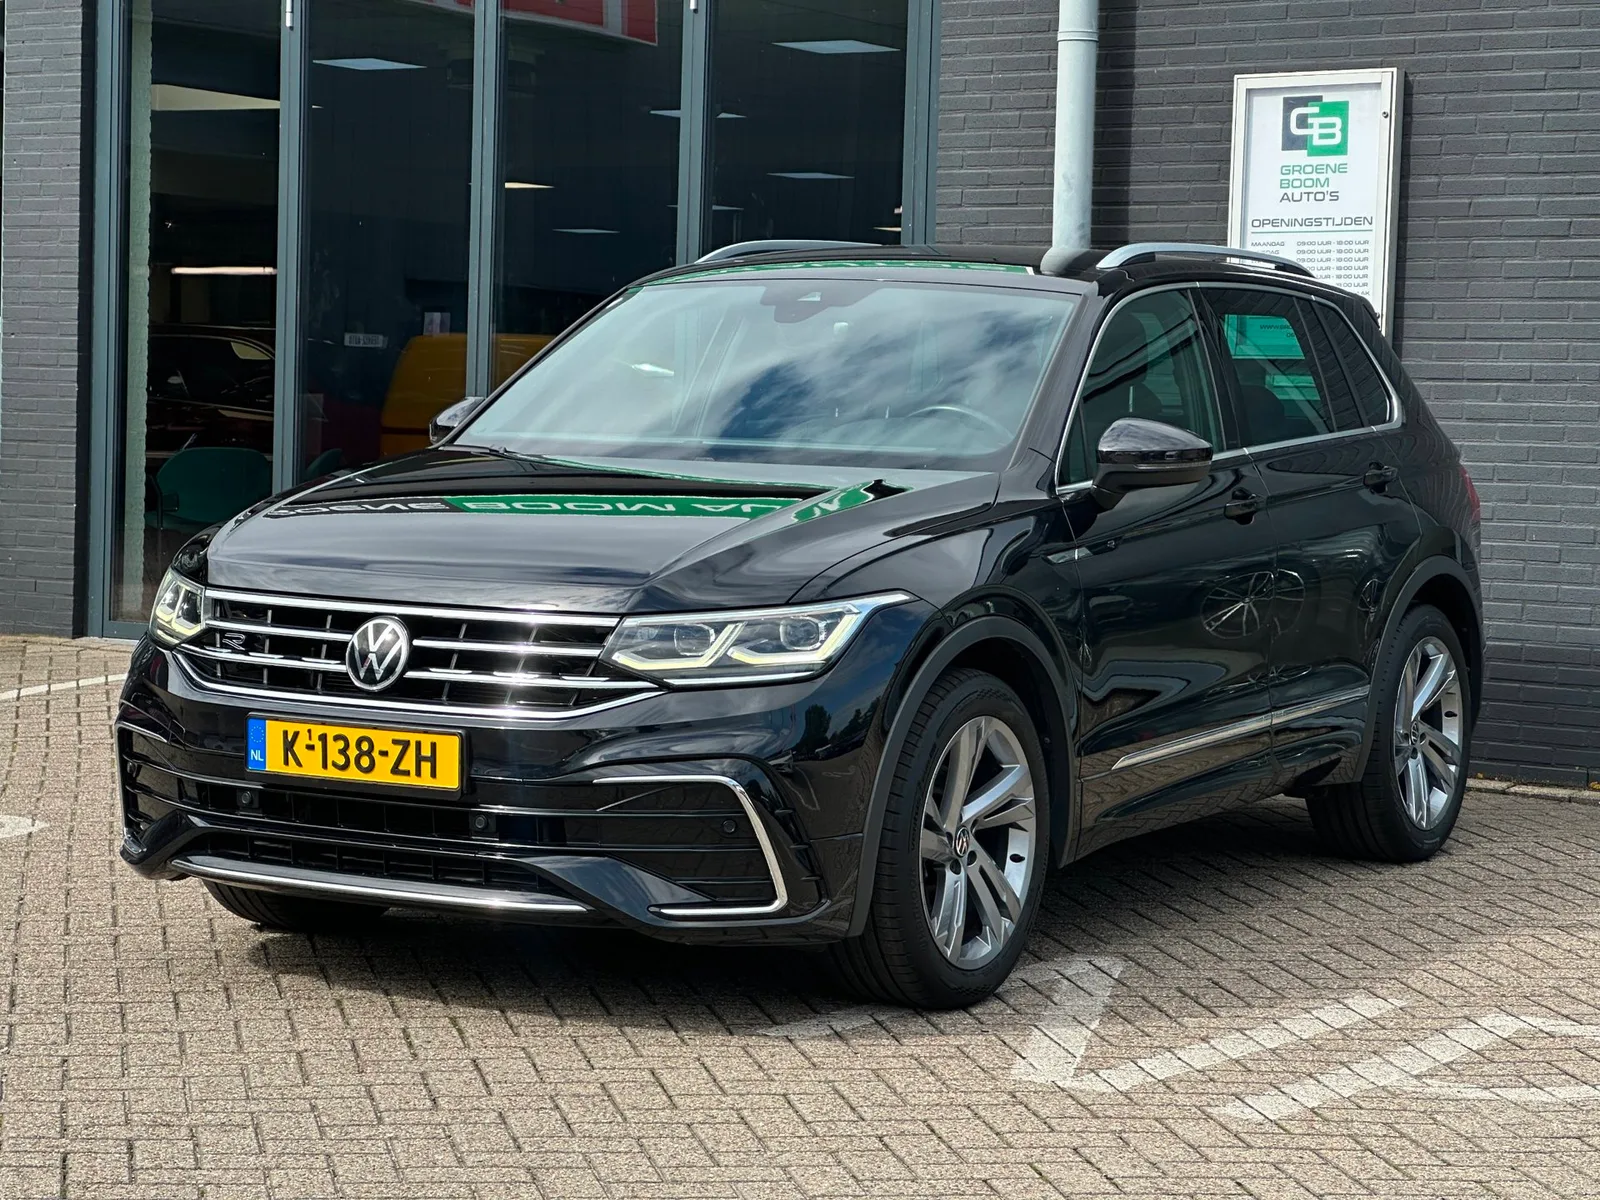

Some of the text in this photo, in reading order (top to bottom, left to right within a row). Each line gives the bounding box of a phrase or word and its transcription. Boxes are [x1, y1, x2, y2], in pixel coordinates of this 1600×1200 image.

[1280, 163, 1348, 175] GROENE
[1279, 178, 1330, 189] BOOM
[1279, 191, 1340, 203] AUTO'S
[1251, 216, 1373, 228] OPENINGSTIJDEN
[222, 633, 246, 650] R
[348, 617, 408, 688] VW
[250, 749, 264, 763] NL
[282, 729, 438, 779] K-138-ZH
